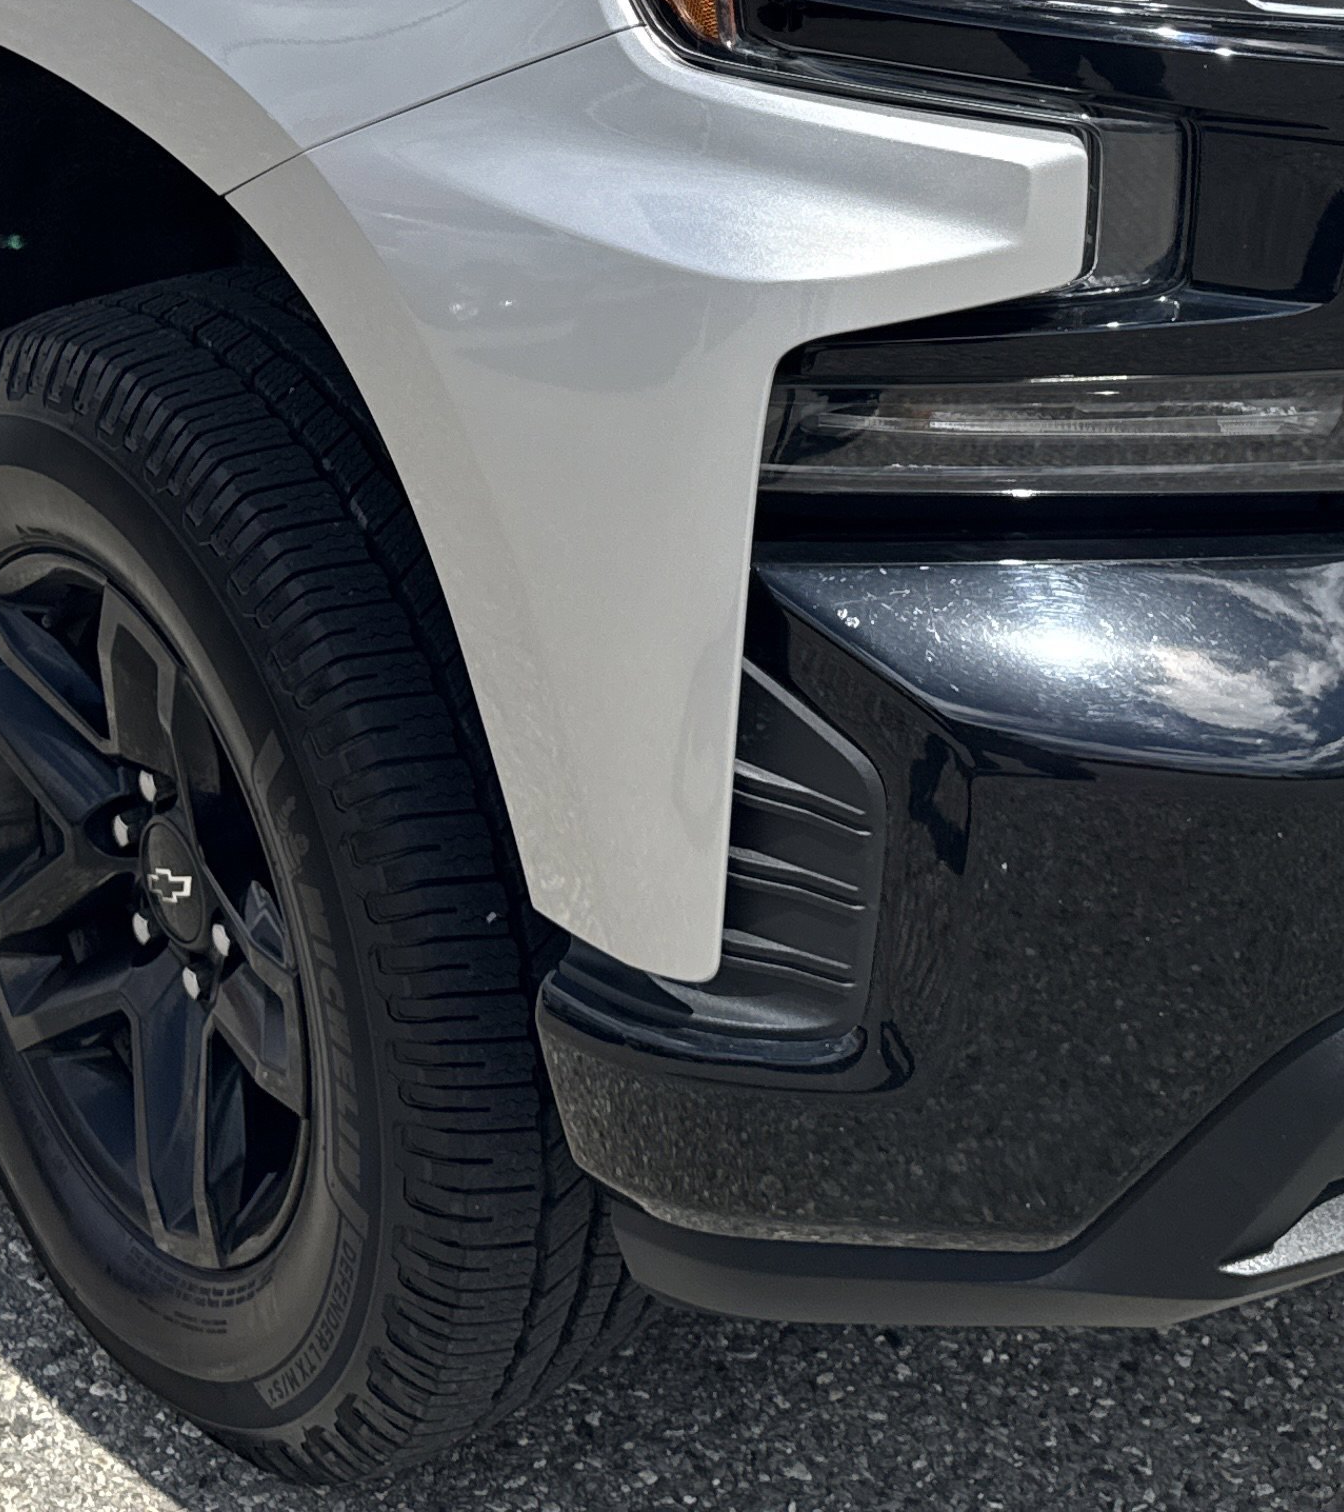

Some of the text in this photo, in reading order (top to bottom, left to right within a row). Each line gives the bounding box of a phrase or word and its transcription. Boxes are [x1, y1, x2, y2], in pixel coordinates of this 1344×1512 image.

[299, 883, 361, 1192] MICHELIN
[316, 1239, 355, 1349] DEFENDER
[295, 1341, 322, 1379] LTX
